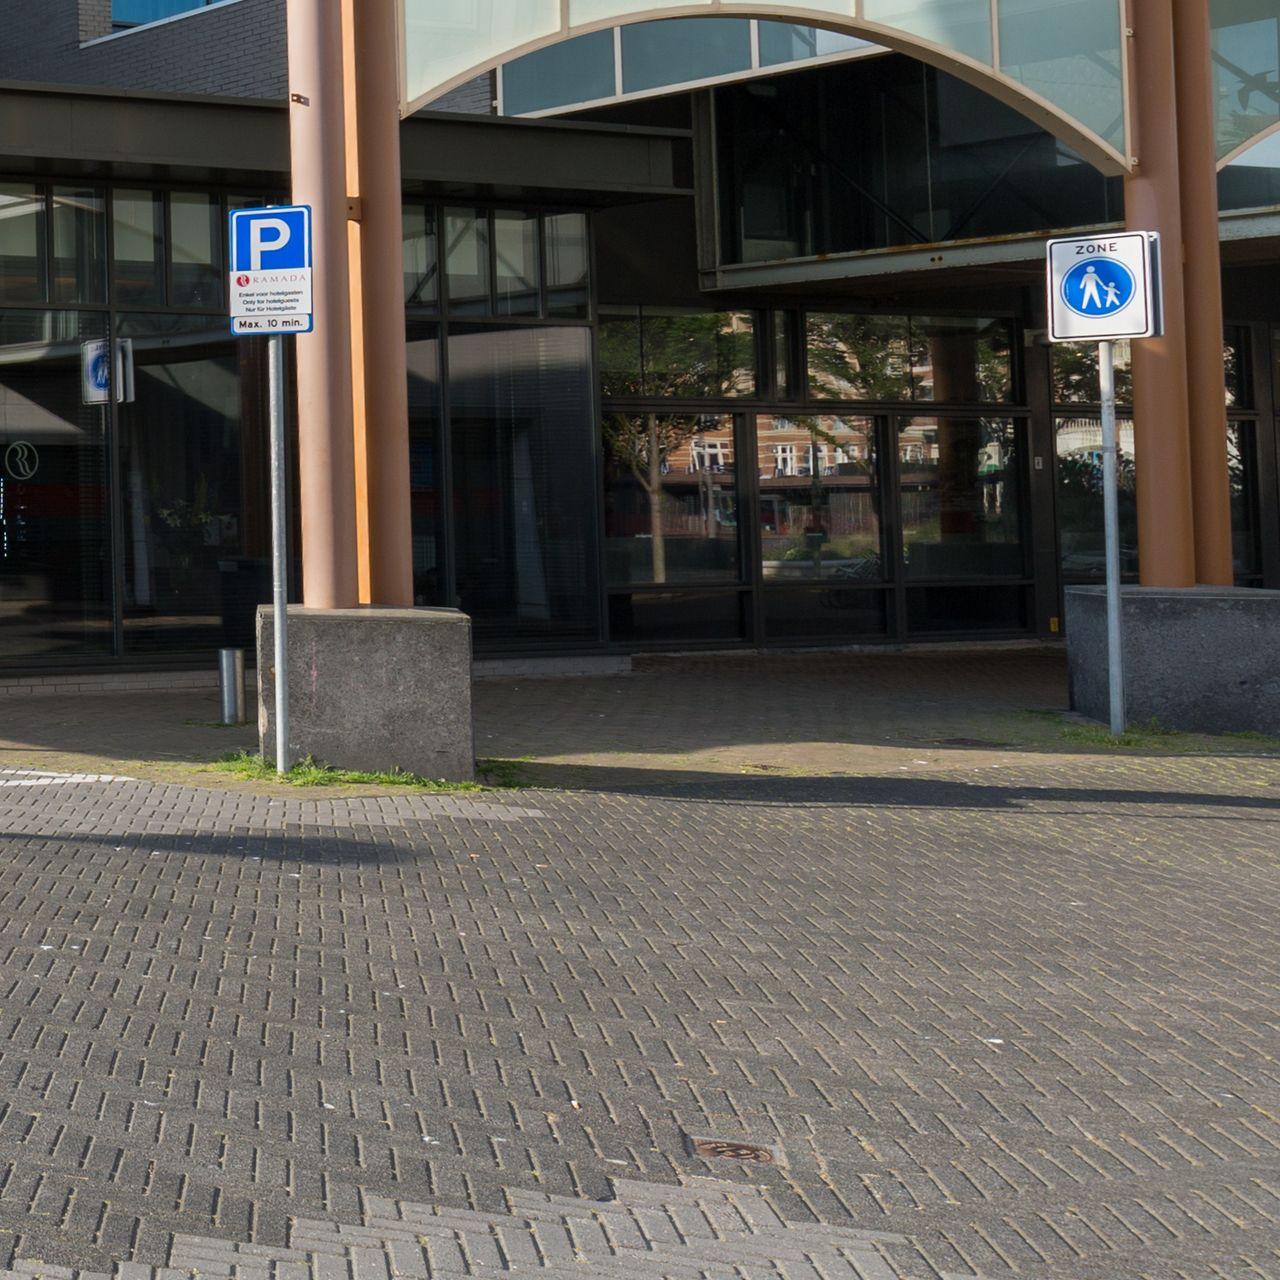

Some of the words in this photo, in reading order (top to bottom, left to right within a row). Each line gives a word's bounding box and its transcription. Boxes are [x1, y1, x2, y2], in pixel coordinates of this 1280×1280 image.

[250, 218, 291, 271] P
[1075, 242, 1118, 255] ZONE
[253, 274, 307, 284] RAMADA
[239, 320, 262, 329] Max.
[267, 319, 278, 328] 10
[282, 318, 303, 327] min.
